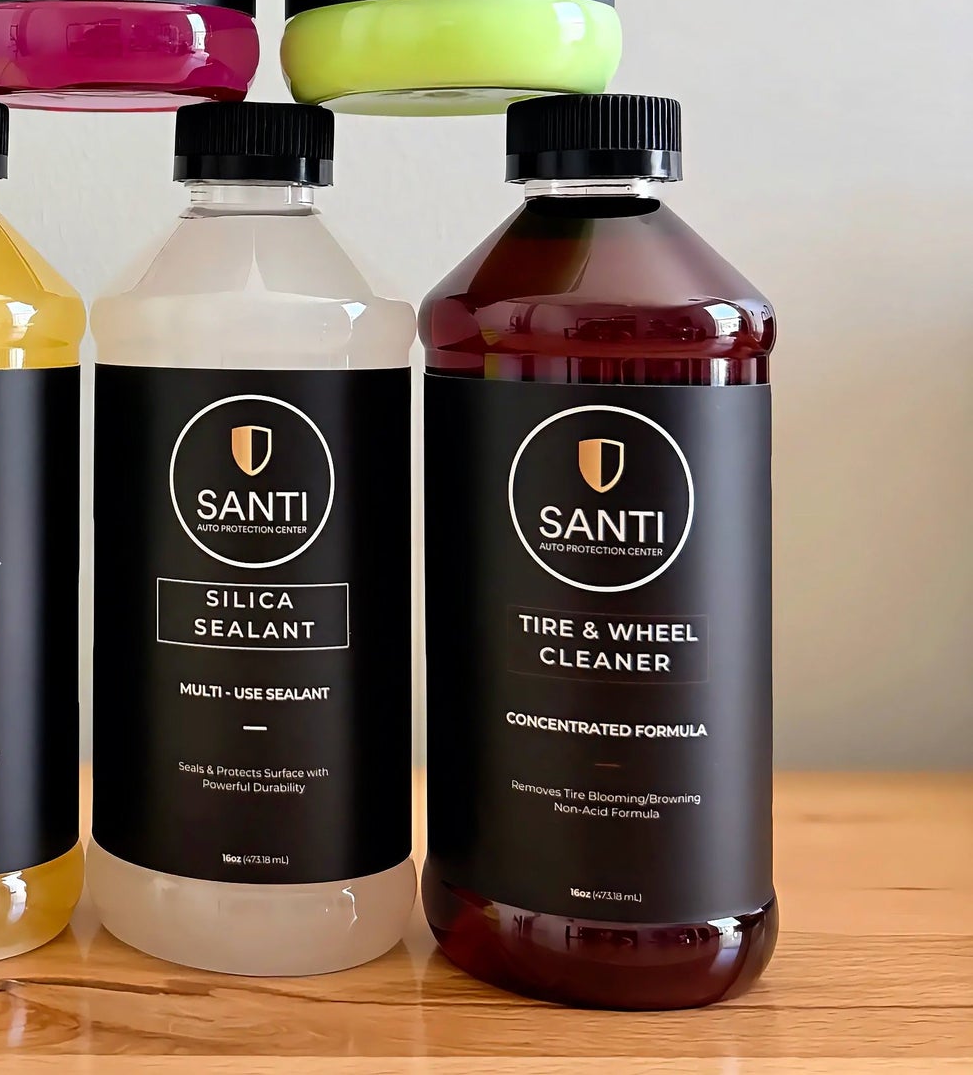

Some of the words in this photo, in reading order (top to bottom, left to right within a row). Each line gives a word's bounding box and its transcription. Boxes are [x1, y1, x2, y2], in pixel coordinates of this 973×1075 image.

[197, 490, 307, 521] SANTI
[197, 524, 219, 532] AUTO
[221, 525, 273, 533] PROTECTION
[540, 506, 663, 543] SANTI
[539, 542, 564, 551] AUTO
[567, 544, 625, 555] PROTECTION
[628, 548, 663, 556] CENTER
[207, 590, 293, 609] SILICA
[195, 619, 314, 638] SEALANT
[519, 615, 573, 637] TIRE
[583, 622, 598, 639] &
[608, 623, 699, 642] WHEEL
[540, 647, 669, 671] CLEANER
[181, 683, 221, 697] MULTI
[235, 687, 262, 700] USE
[266, 687, 330, 700] SEALANT
[506, 712, 631, 736] CONCENTRATED
[636, 724, 708, 737] FORMULA
[179, 762, 204, 773] Seals
[207, 765, 214, 774] &
[217, 766, 261, 777] Protects
[265, 768, 304, 778] Surface
[307, 768, 328, 777] with
[203, 779, 250, 791] Powerful
[254, 783, 305, 794] Durability
[512, 780, 561, 796] Removes
[564, 789, 585, 799] Tire
[589, 791, 701, 805] Blooming/Browning
[554, 802, 607, 816] Non-Acid
[612, 808, 659, 818] Formula
[222, 854, 241, 863] 16oz
[272, 856, 288, 864] mL)
[571, 888, 591, 898] 16oz
[624, 894, 641, 902] mL)
